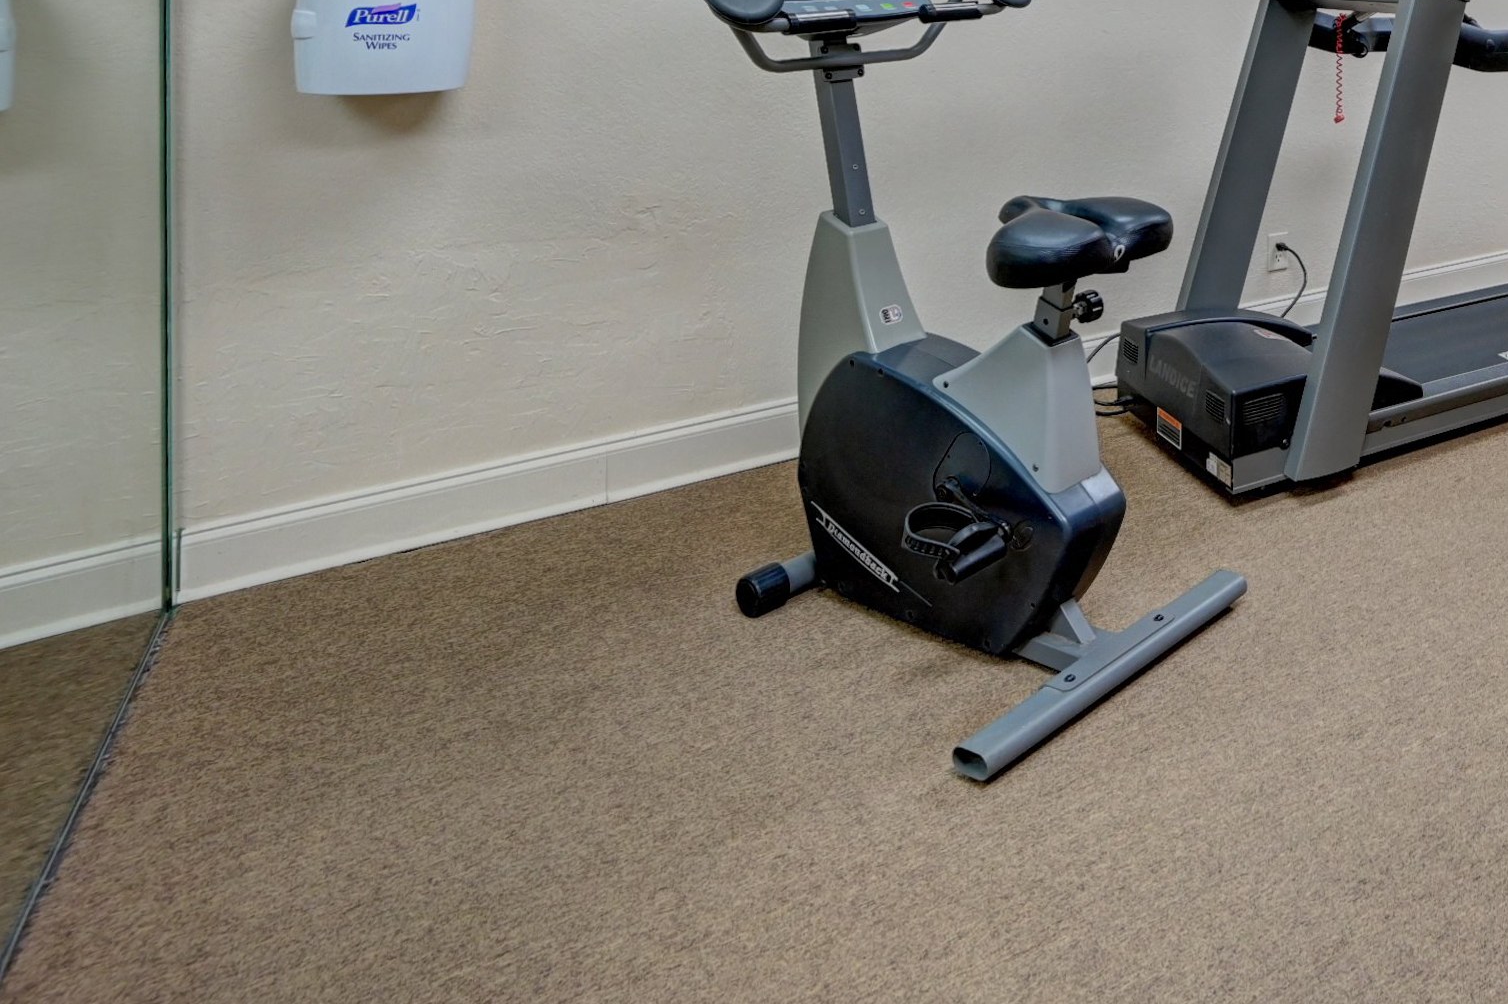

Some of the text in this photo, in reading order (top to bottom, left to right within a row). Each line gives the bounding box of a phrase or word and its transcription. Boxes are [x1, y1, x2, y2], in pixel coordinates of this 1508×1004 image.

[353, 9, 409, 23] Purell
[353, 32, 410, 42] SANITIZING
[366, 41, 398, 50] WIPES
[1148, 356, 1196, 398] LANDICE
[827, 522, 889, 582] Diamondback
